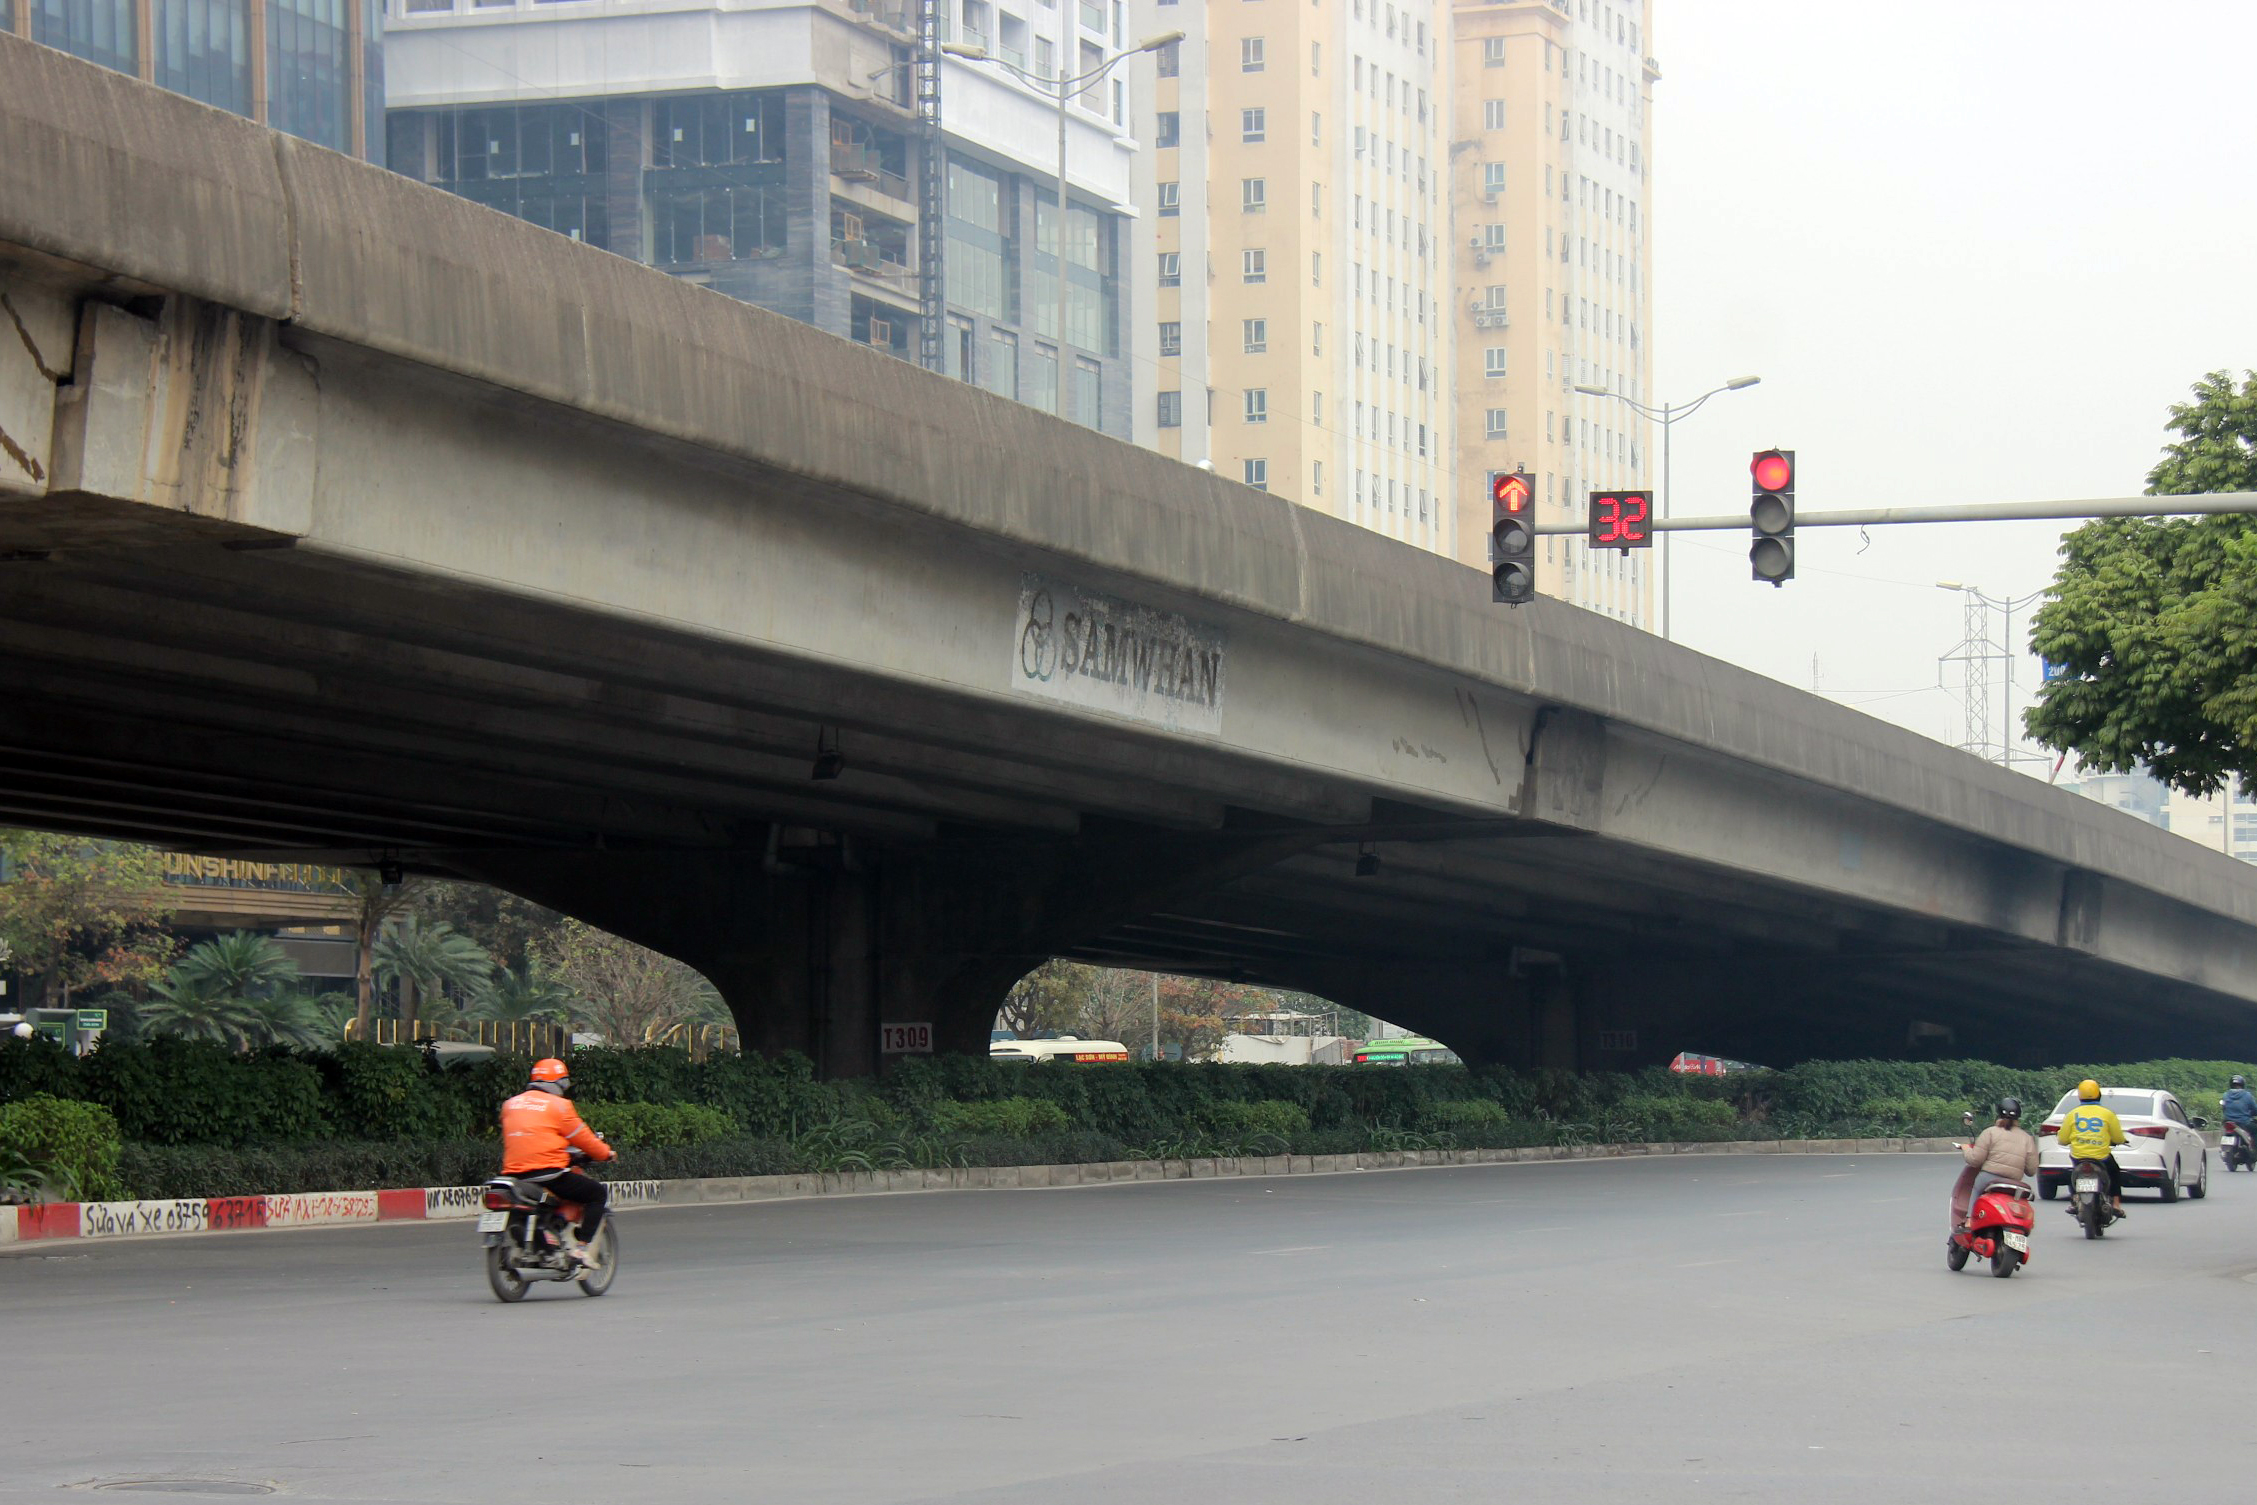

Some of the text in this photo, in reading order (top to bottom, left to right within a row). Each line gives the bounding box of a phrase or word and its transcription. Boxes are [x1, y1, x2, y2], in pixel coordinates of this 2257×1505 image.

[1599, 497, 1647, 541] 32
[884, 1027, 928, 1049] T309
[2075, 1112, 2103, 1132] be
